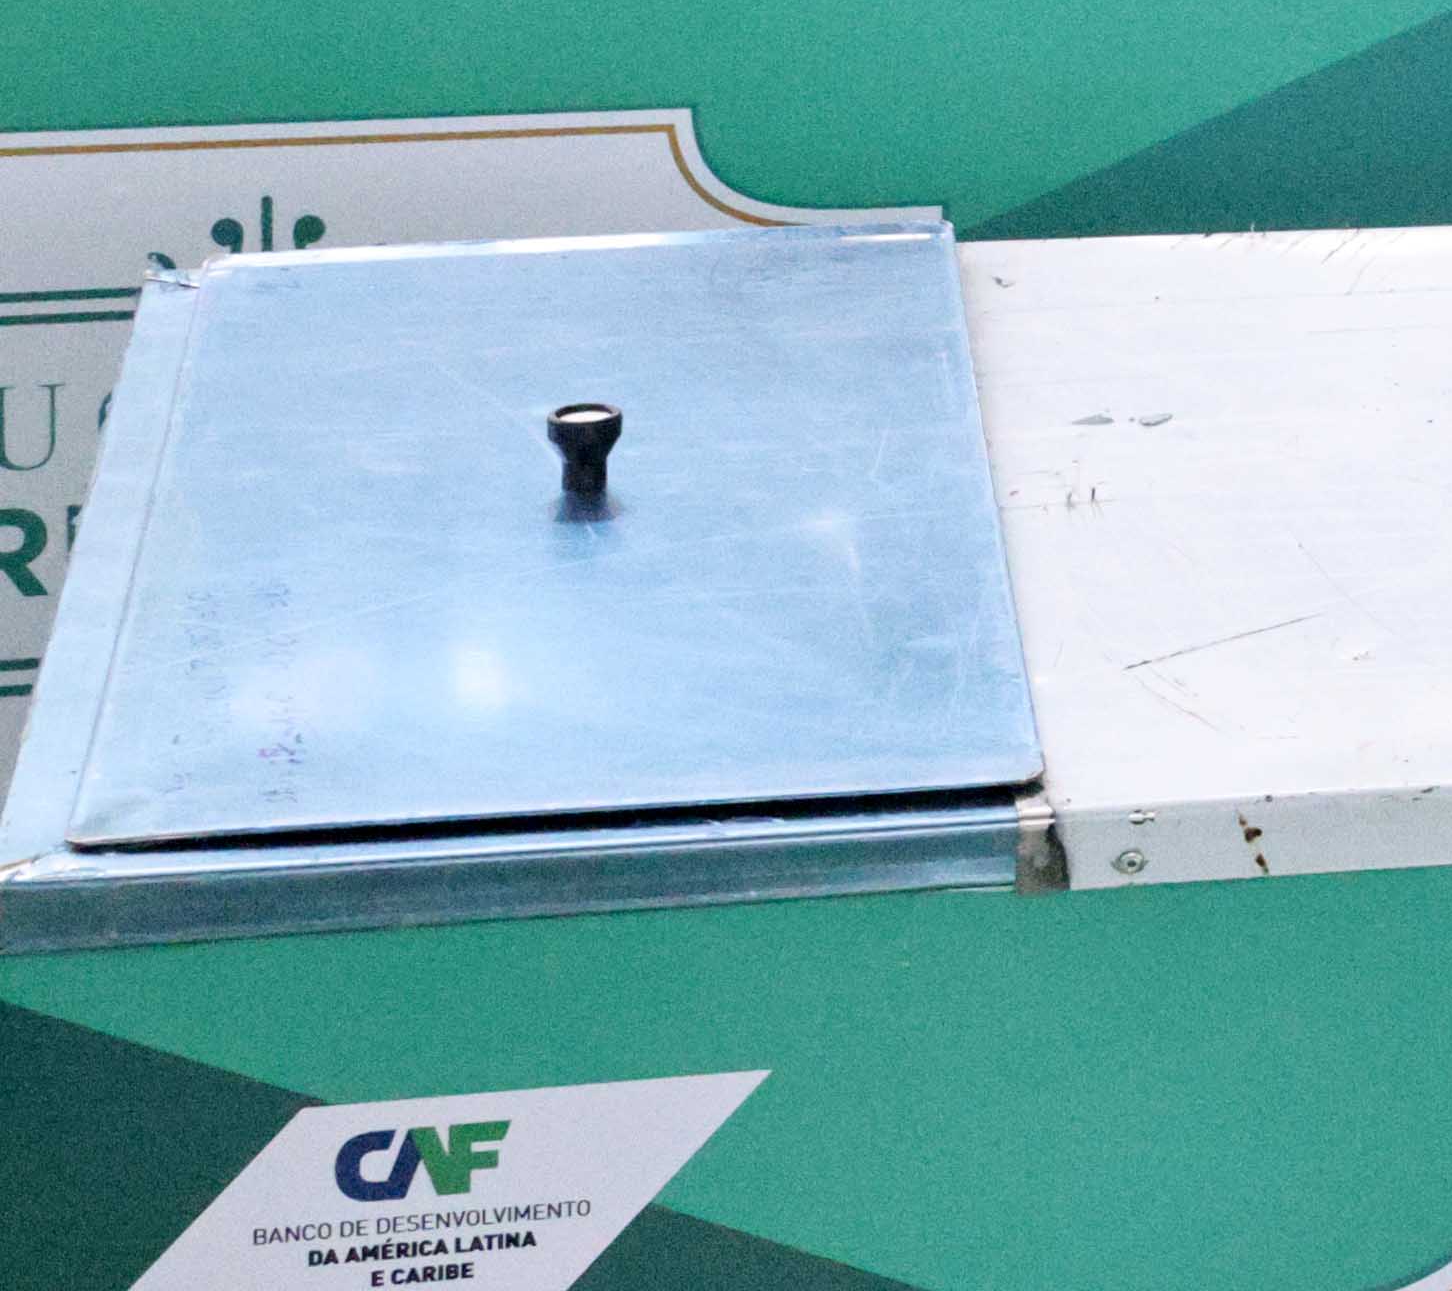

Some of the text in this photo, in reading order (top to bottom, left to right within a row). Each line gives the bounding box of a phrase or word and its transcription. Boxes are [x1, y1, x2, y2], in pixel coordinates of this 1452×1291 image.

[334, 1119, 512, 1202] CAF
[253, 1199, 592, 1246] BANCO DE DESENVOLVIMENTO
[308, 1230, 537, 1267] DA AMÉRICA LATINA
[371, 1262, 475, 1288] E CARIBE
